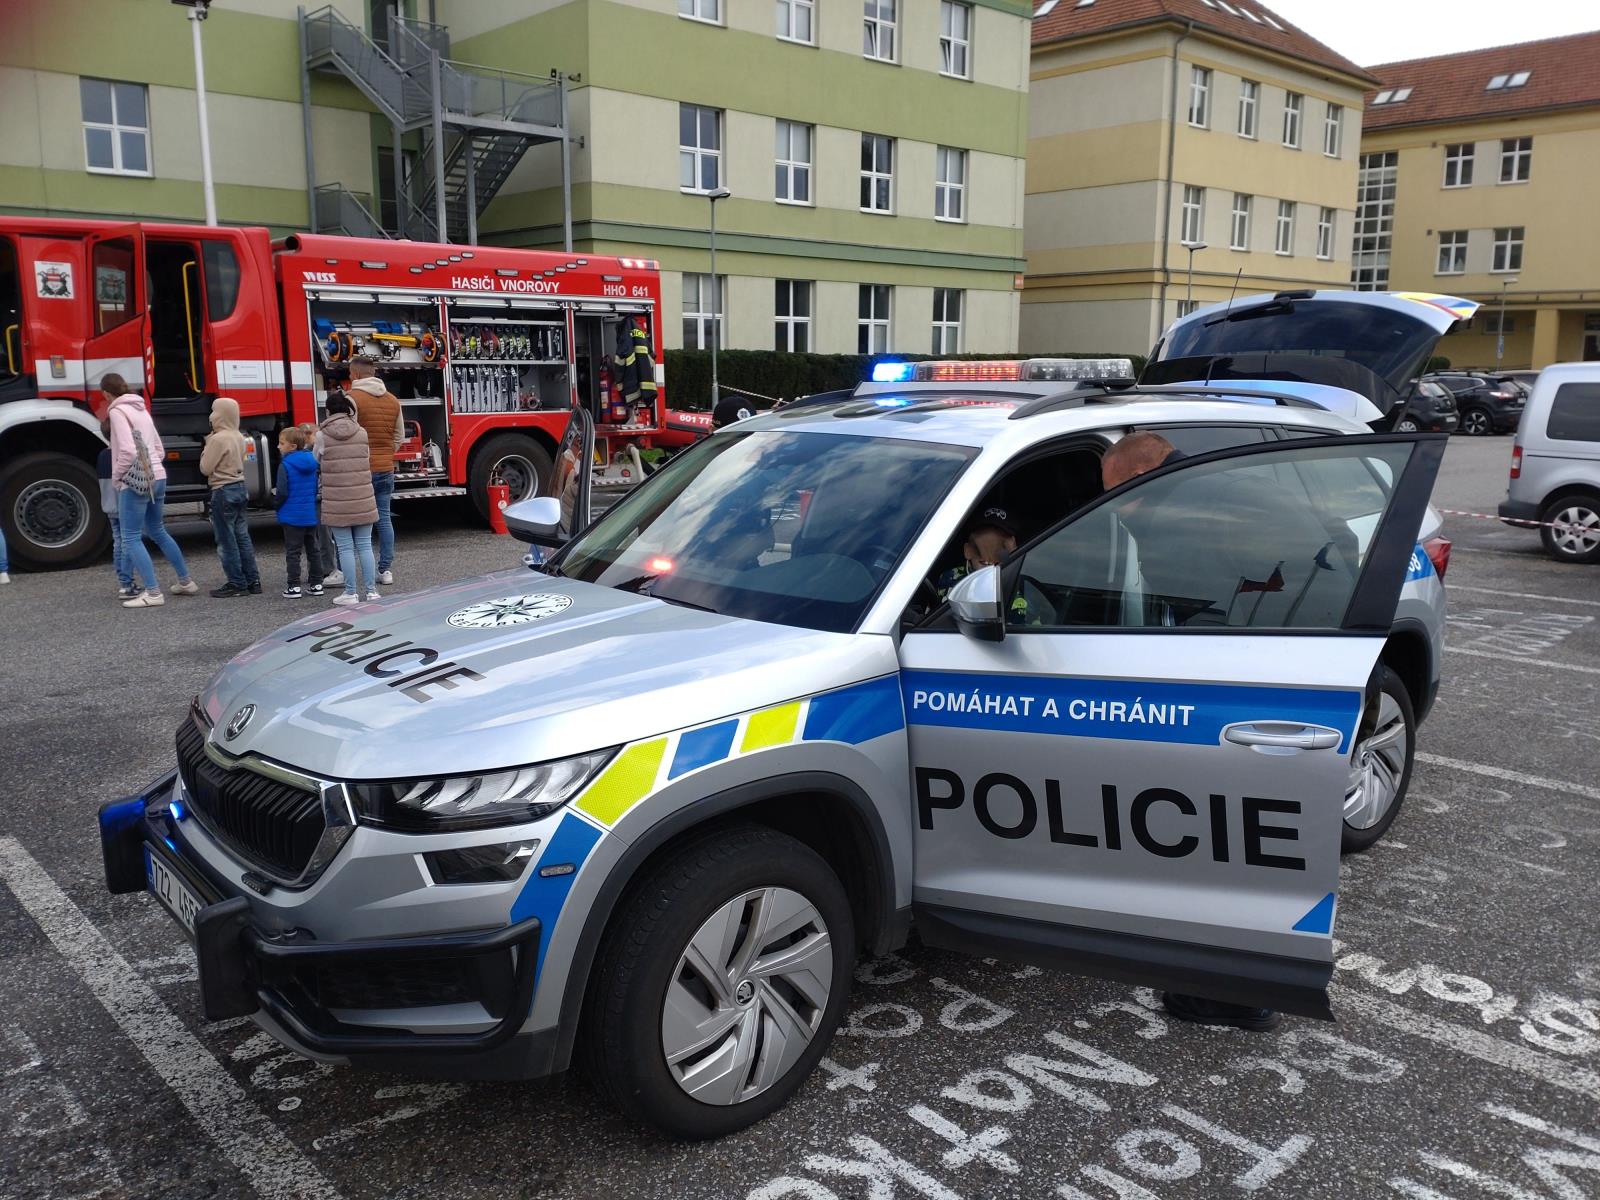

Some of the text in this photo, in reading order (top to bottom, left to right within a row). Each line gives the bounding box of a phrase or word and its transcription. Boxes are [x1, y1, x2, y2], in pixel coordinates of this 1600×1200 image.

[452, 275, 560, 293] HASIČI VNOROVY
[603, 285, 649, 297] HHO 641
[679, 414, 712, 425] 601 77
[285, 622, 487, 704] POLICIE
[913, 688, 1195, 726] POMÁHAT A CHRÁNIT
[914, 766, 1307, 871] POLICIE
